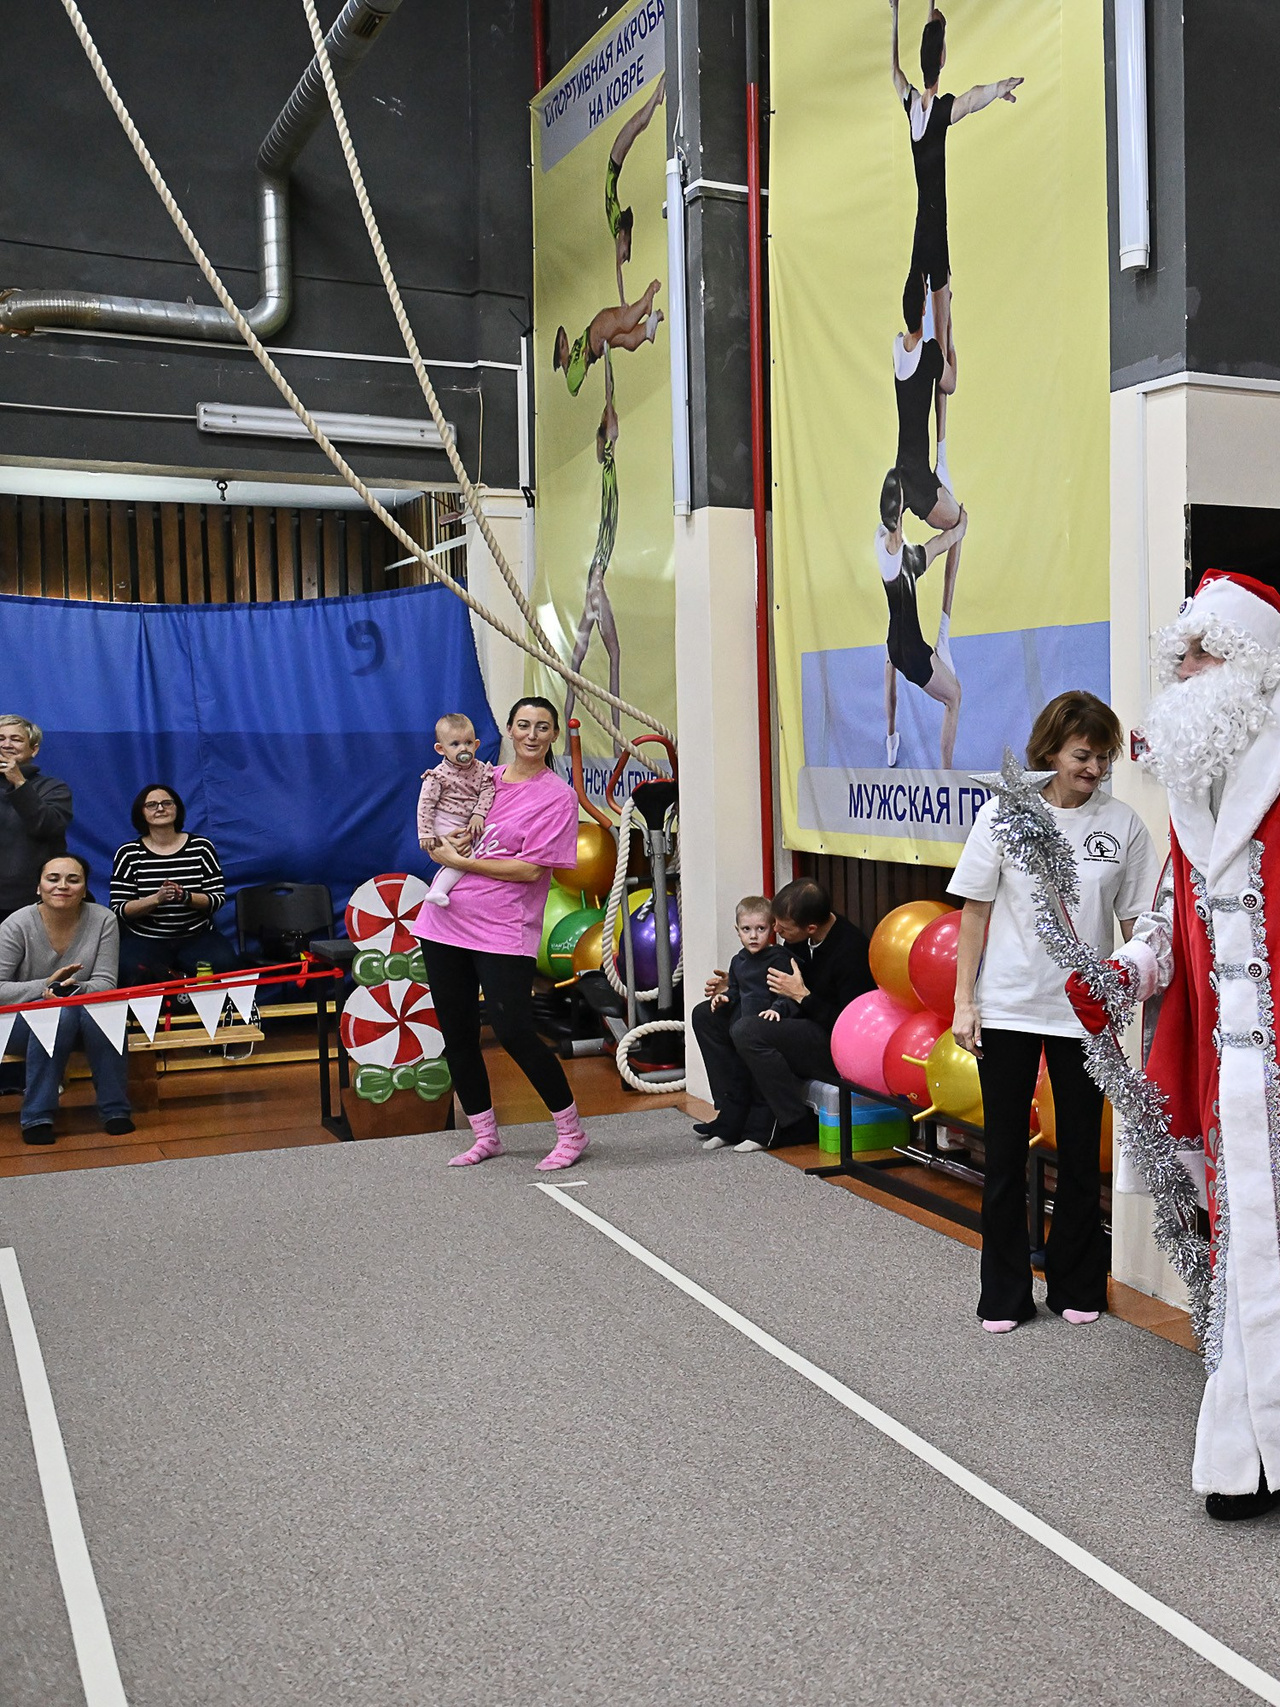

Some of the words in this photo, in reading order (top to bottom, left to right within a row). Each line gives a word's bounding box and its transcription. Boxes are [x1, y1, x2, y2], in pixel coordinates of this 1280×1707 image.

[544, 41, 614, 128] СПОРТИВНАЯ
[588, 93, 604, 128] НА
[606, 54, 644, 114] КОВРЕ
[849, 783, 950, 825] МУЖСКАЯ
